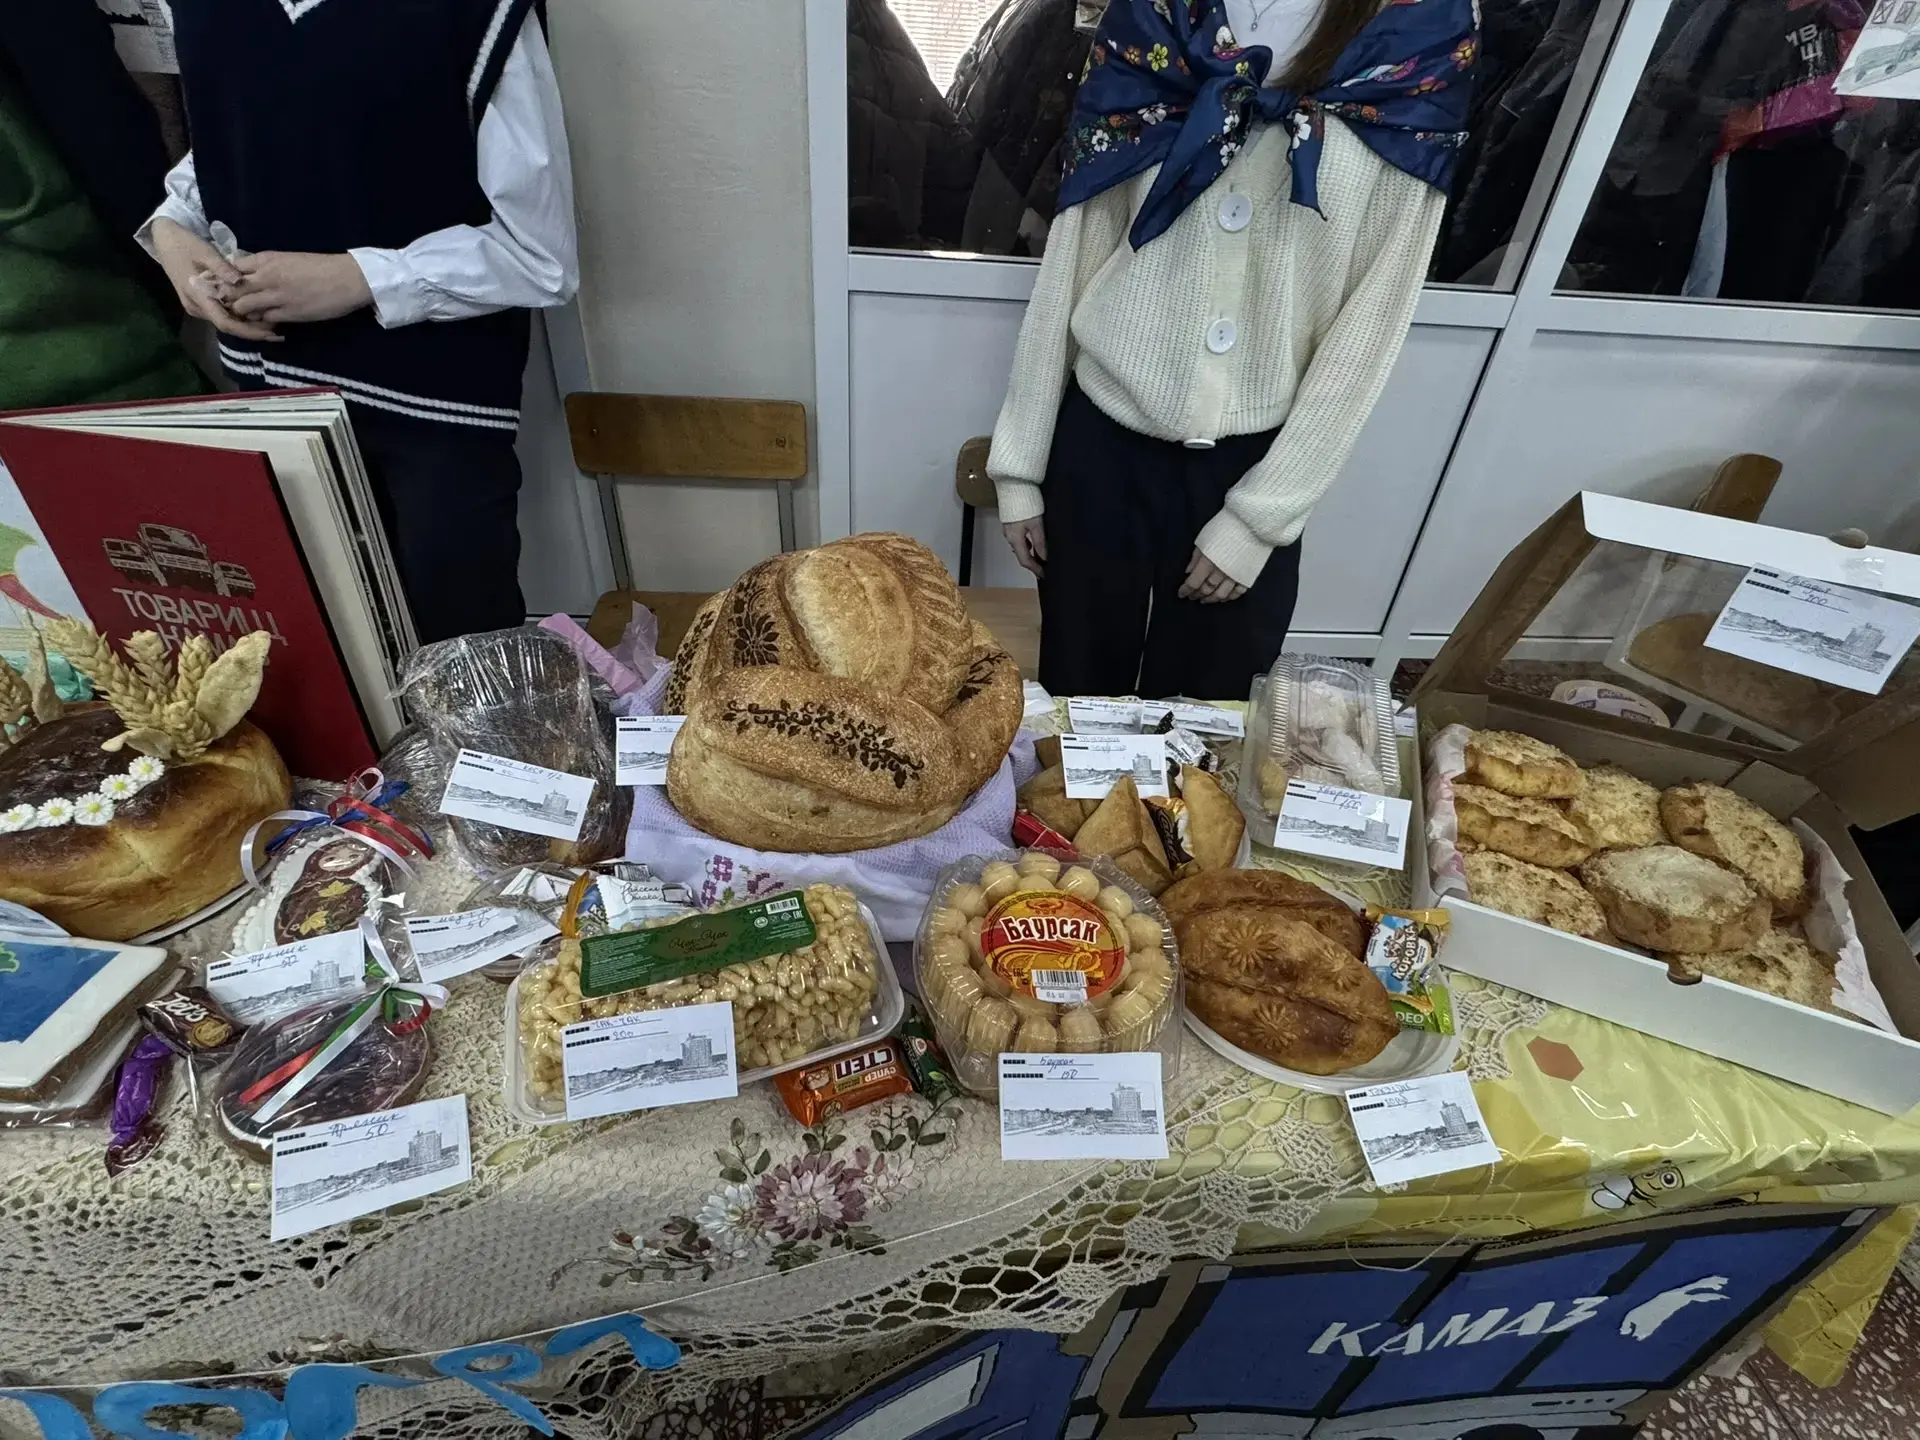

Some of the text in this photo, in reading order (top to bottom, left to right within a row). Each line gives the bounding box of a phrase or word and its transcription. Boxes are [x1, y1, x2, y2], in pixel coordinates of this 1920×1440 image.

[1000, 917, 1101, 944] Баурсак
[1391, 923, 1418, 980] КОРОВКА
[835, 1047, 893, 1079] СТЕП
[865, 1066, 897, 1082] СУПЕР
[365, 1122, 389, 1140] 50
